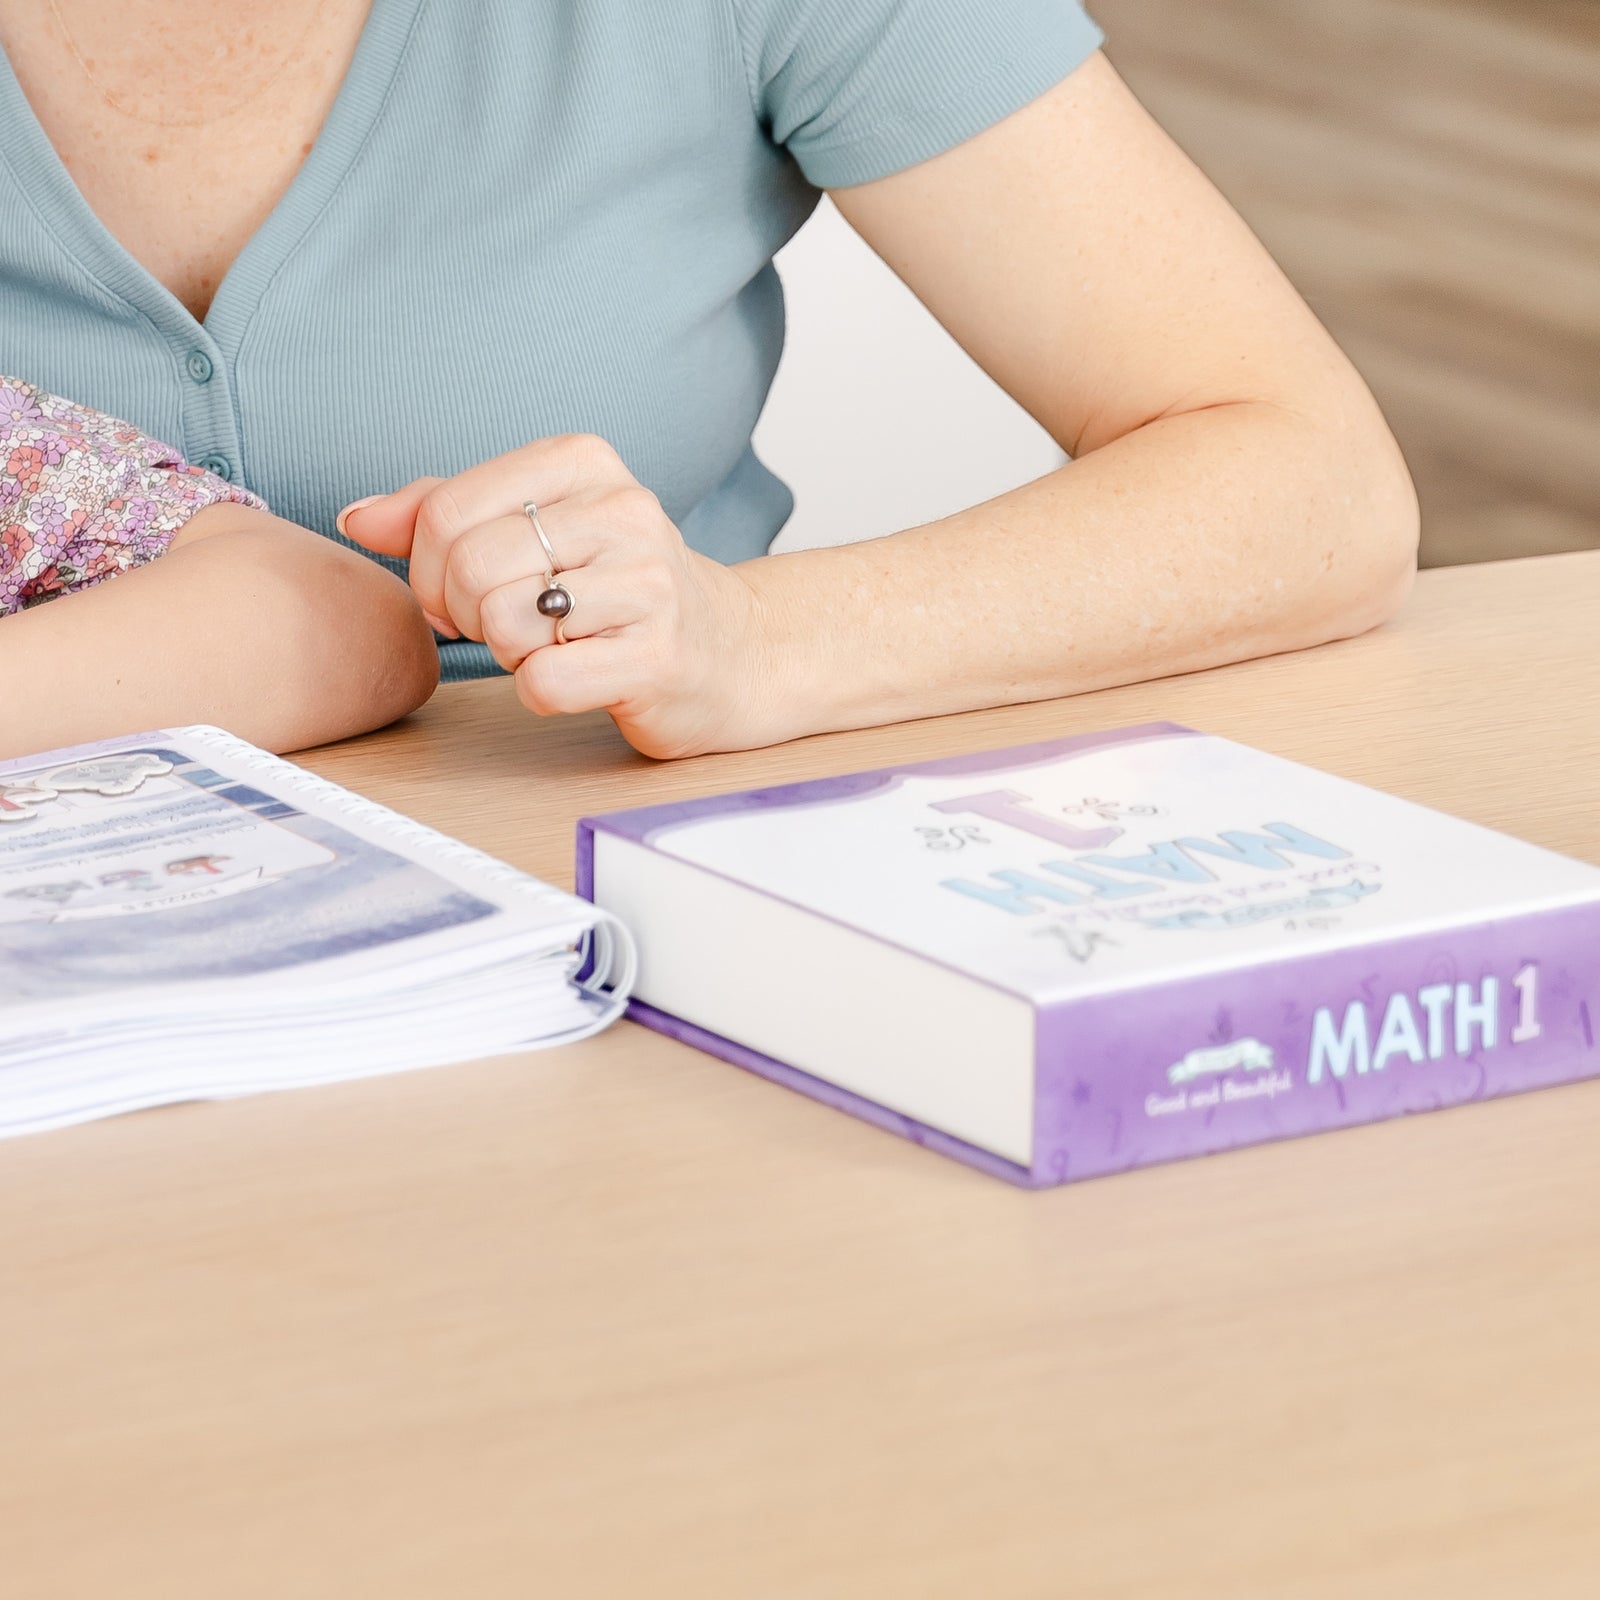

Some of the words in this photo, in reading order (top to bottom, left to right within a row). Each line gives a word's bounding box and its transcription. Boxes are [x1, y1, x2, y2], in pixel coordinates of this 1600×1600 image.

[927, 789, 1125, 850] 1
[938, 821, 1353, 916] MATH
[1307, 975, 1498, 1084] MATH
[1510, 962, 1541, 1043] 1
[1144, 1090, 1186, 1117] Good
[1189, 1083, 1221, 1108] and
[1222, 1067, 1293, 1102] Beautiful
